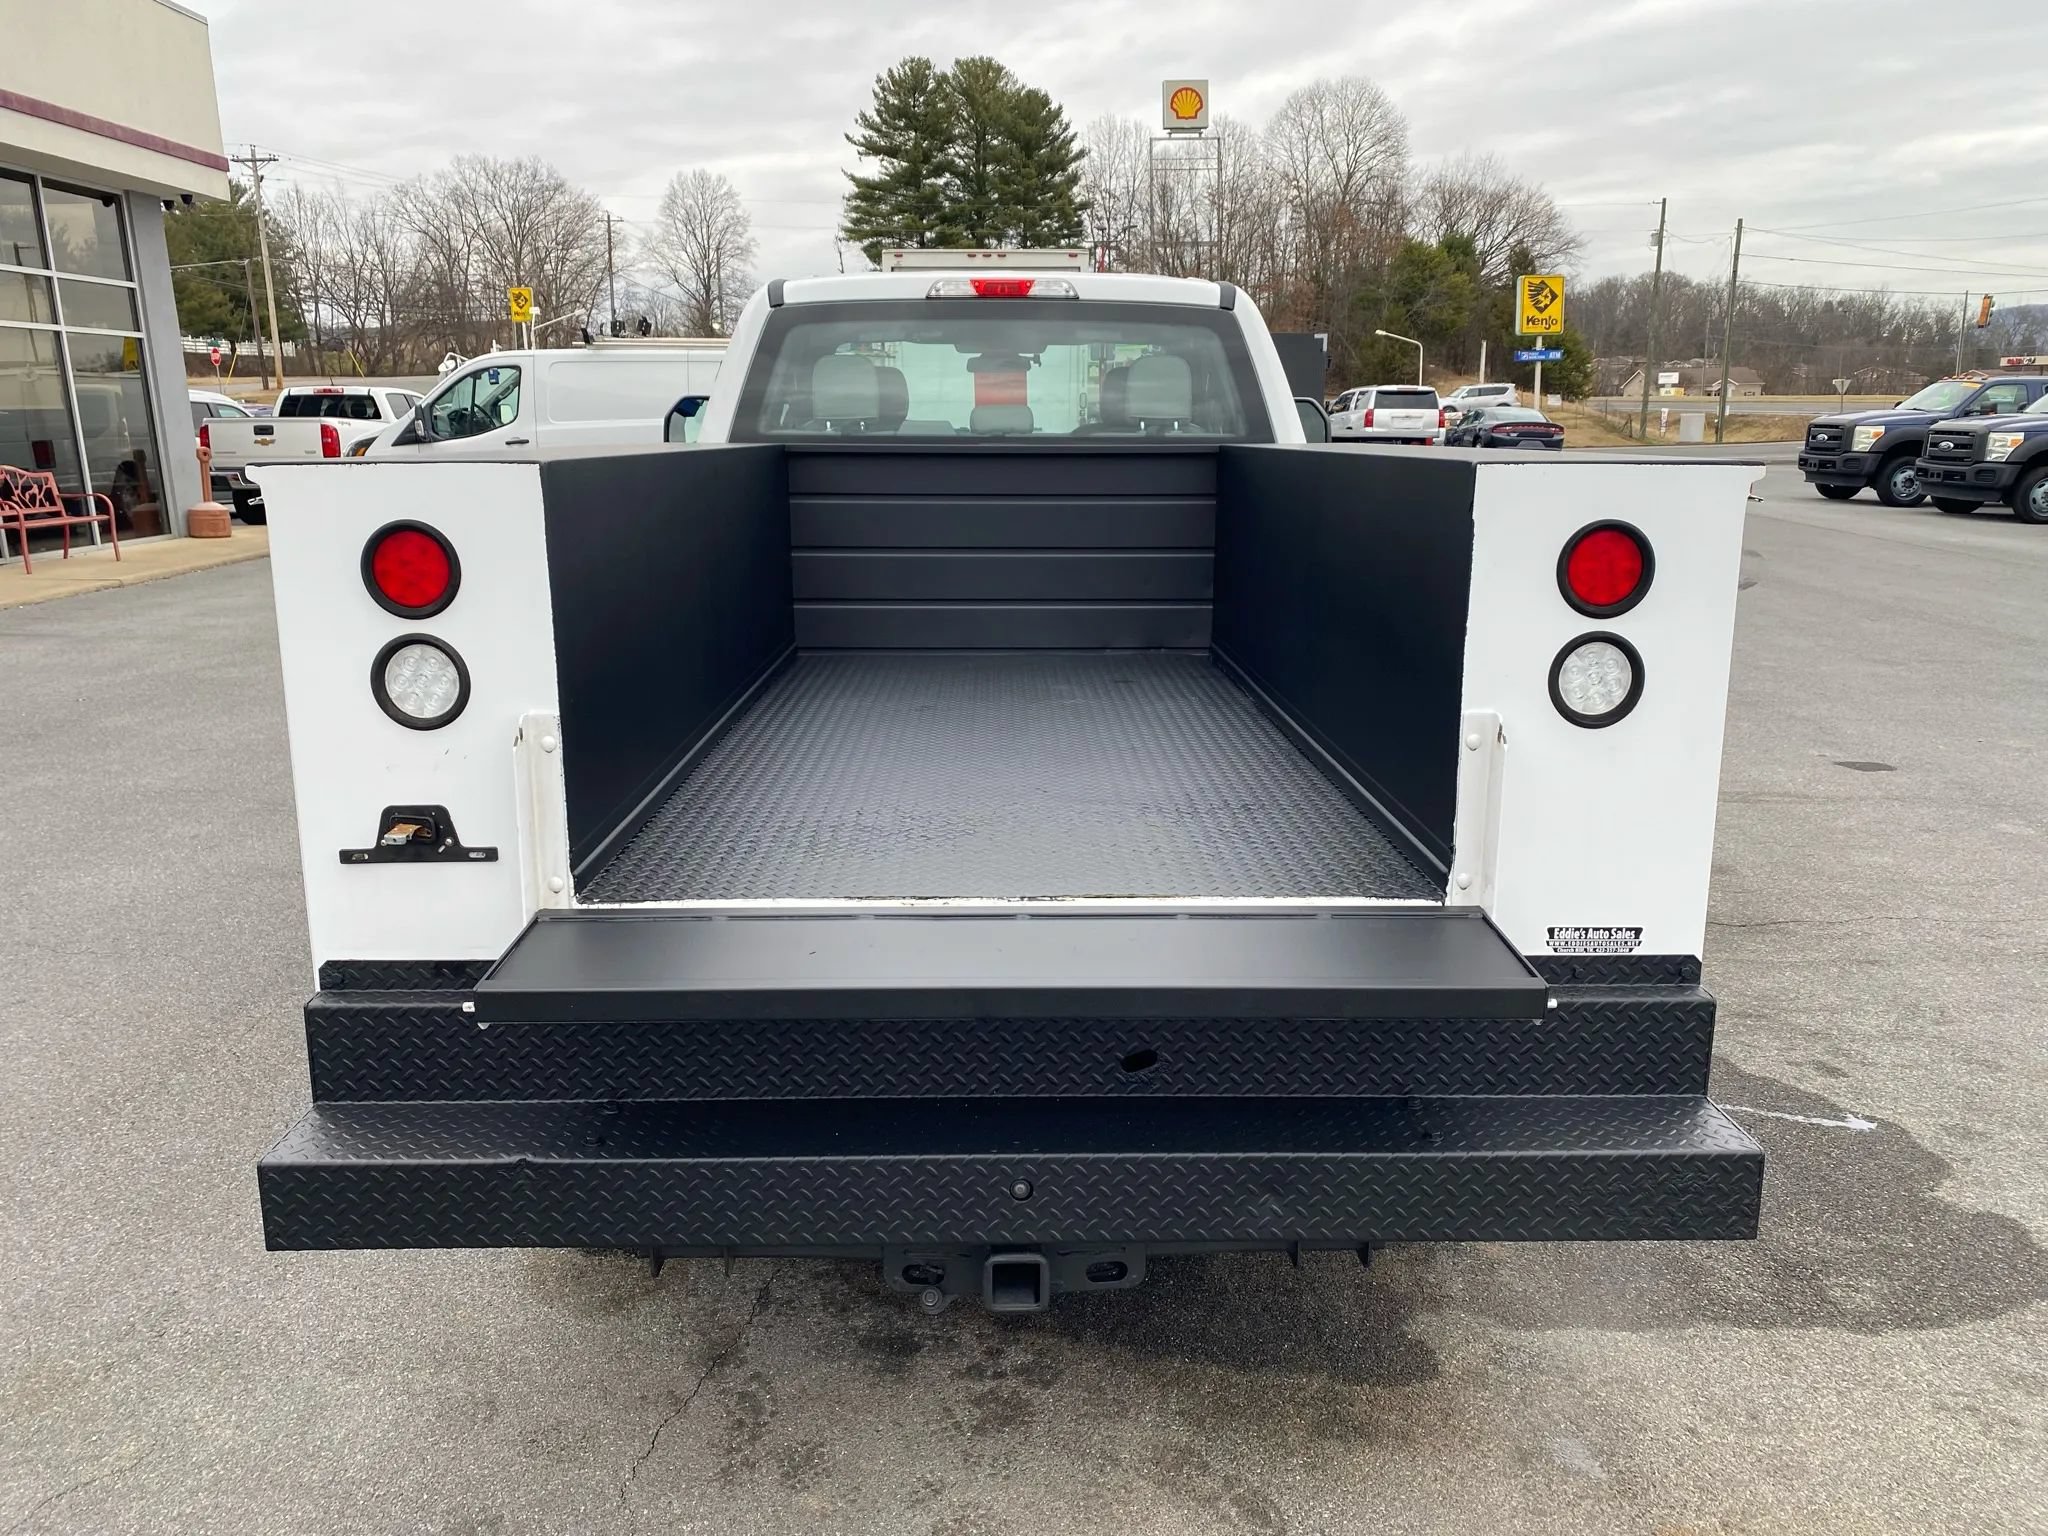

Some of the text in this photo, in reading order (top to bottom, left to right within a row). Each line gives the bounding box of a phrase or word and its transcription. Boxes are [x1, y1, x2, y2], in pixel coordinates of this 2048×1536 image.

[1549, 351, 1561, 360] ATM
[1553, 927, 1636, 939] Eddie's Auto Sales
